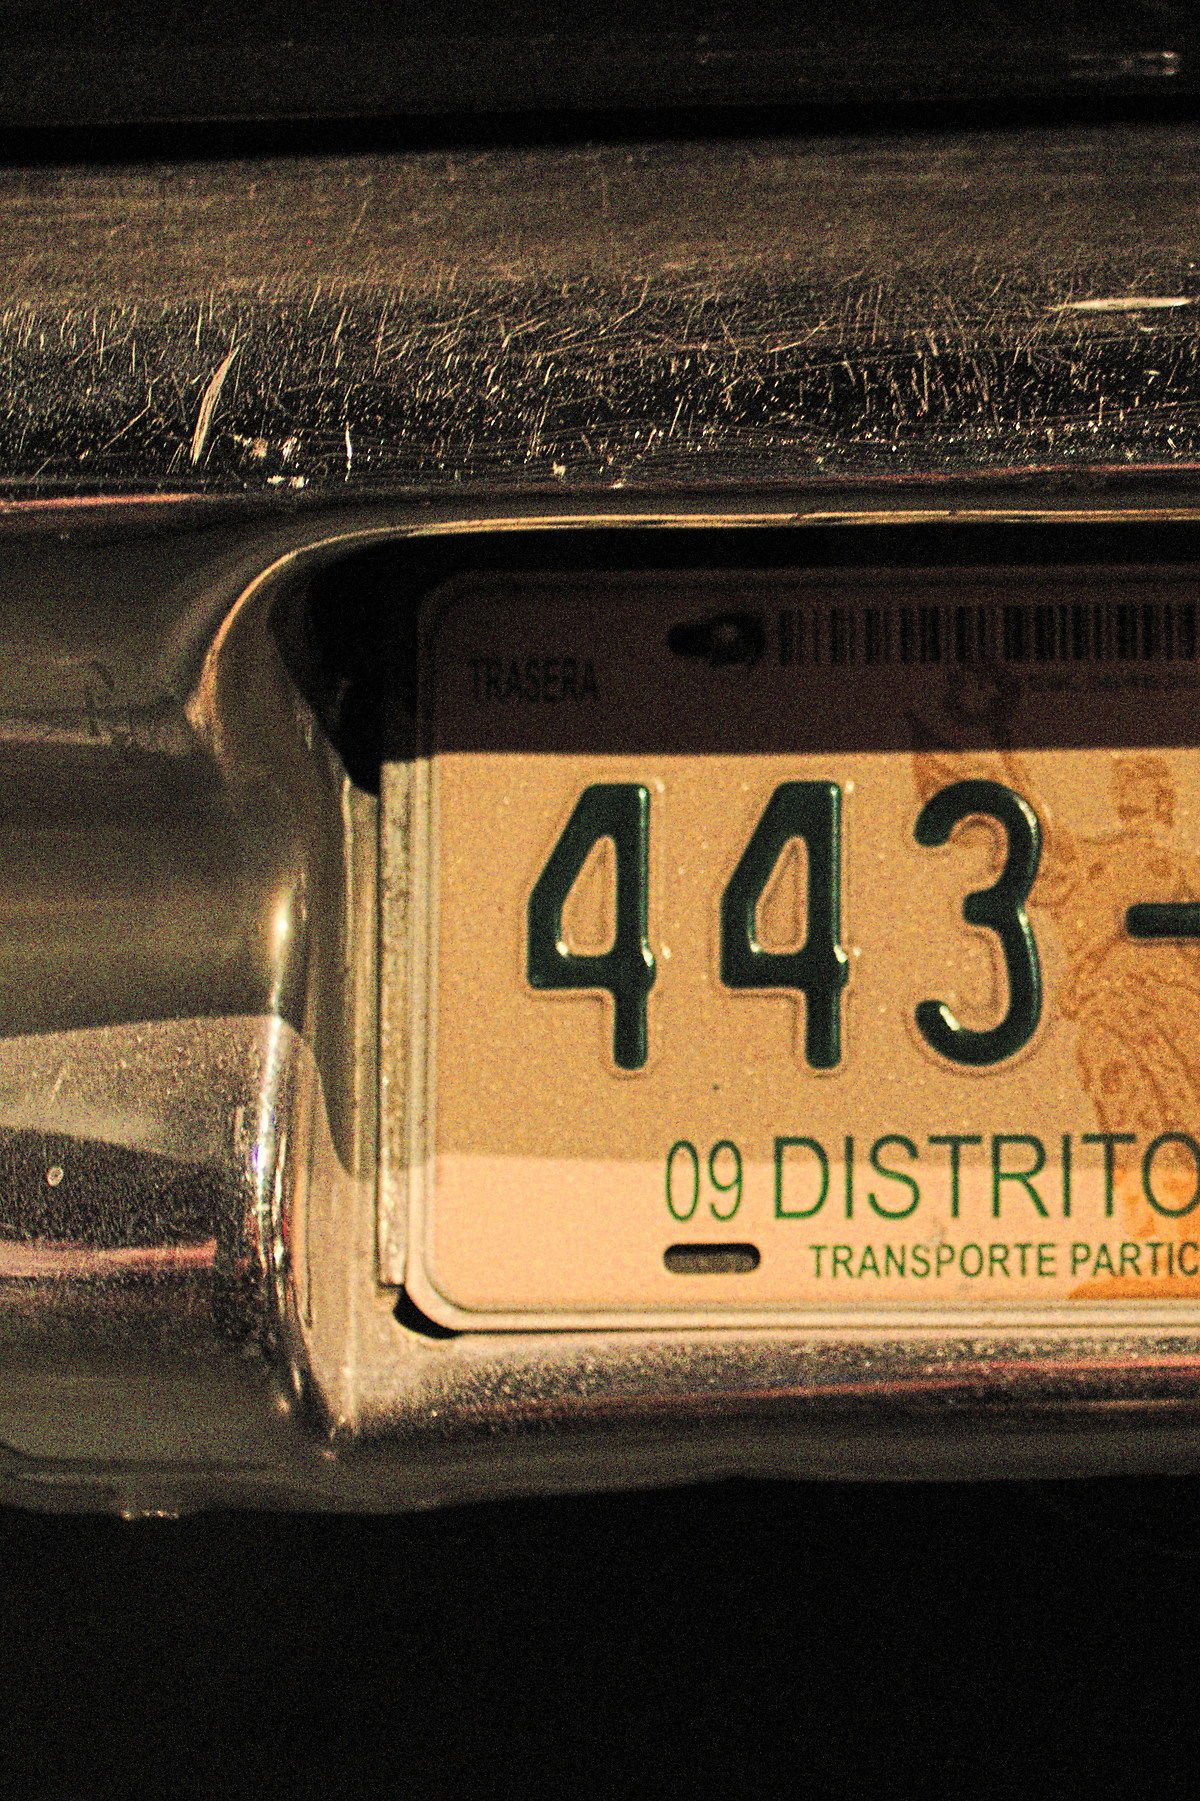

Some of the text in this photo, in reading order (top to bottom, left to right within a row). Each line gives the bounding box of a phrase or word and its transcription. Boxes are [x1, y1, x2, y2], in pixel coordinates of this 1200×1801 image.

[468, 657, 600, 704] TRASERA
[665, 1139, 744, 1222] 09
[808, 1242, 1058, 1279] TRANSPORTE
